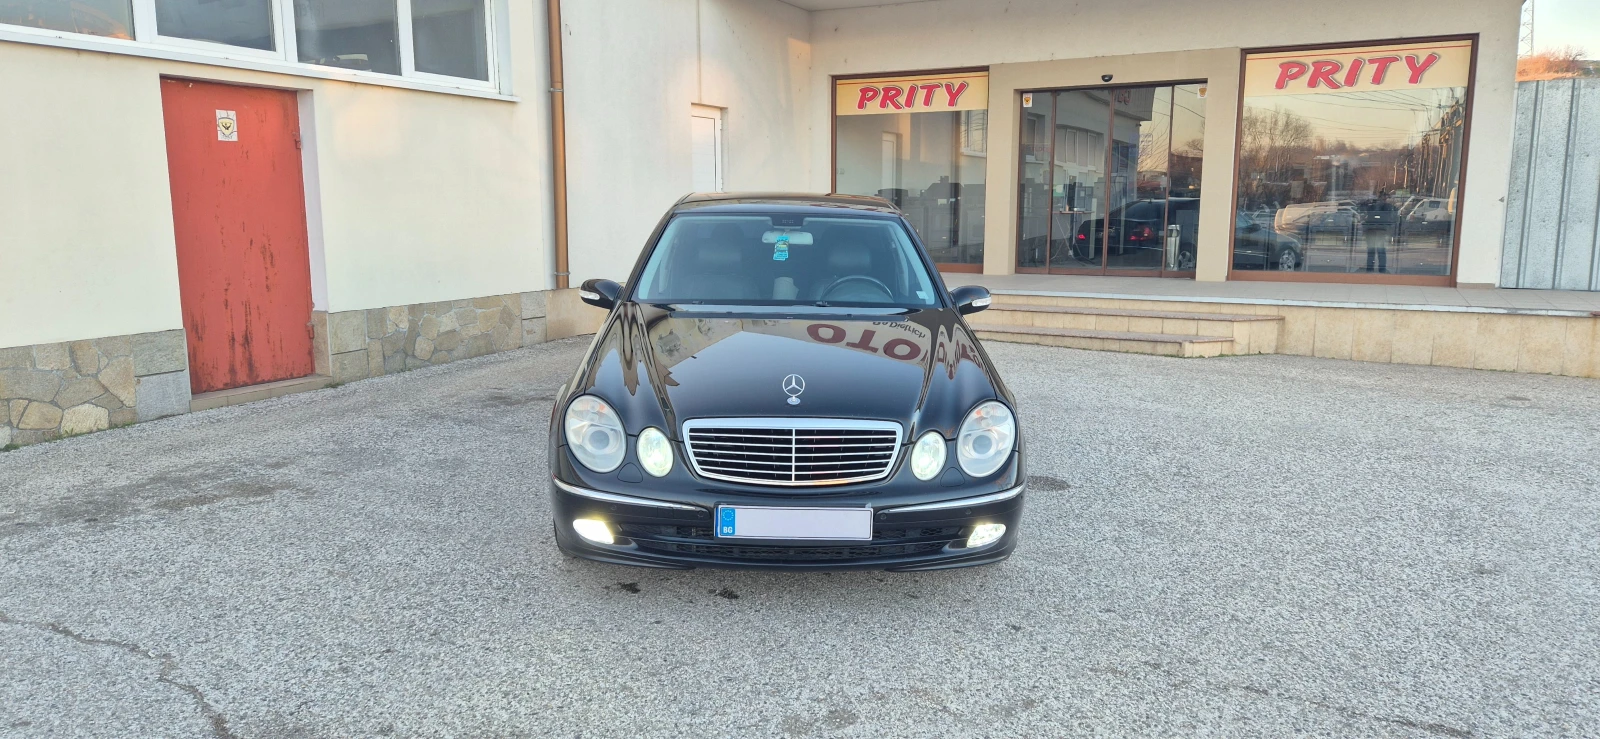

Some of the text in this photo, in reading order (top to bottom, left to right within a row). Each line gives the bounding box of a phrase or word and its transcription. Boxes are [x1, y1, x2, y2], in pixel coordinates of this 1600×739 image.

[1274, 53, 1440, 90] PRITY
[856, 81, 968, 110] PRITY
[723, 526, 733, 534] BG
